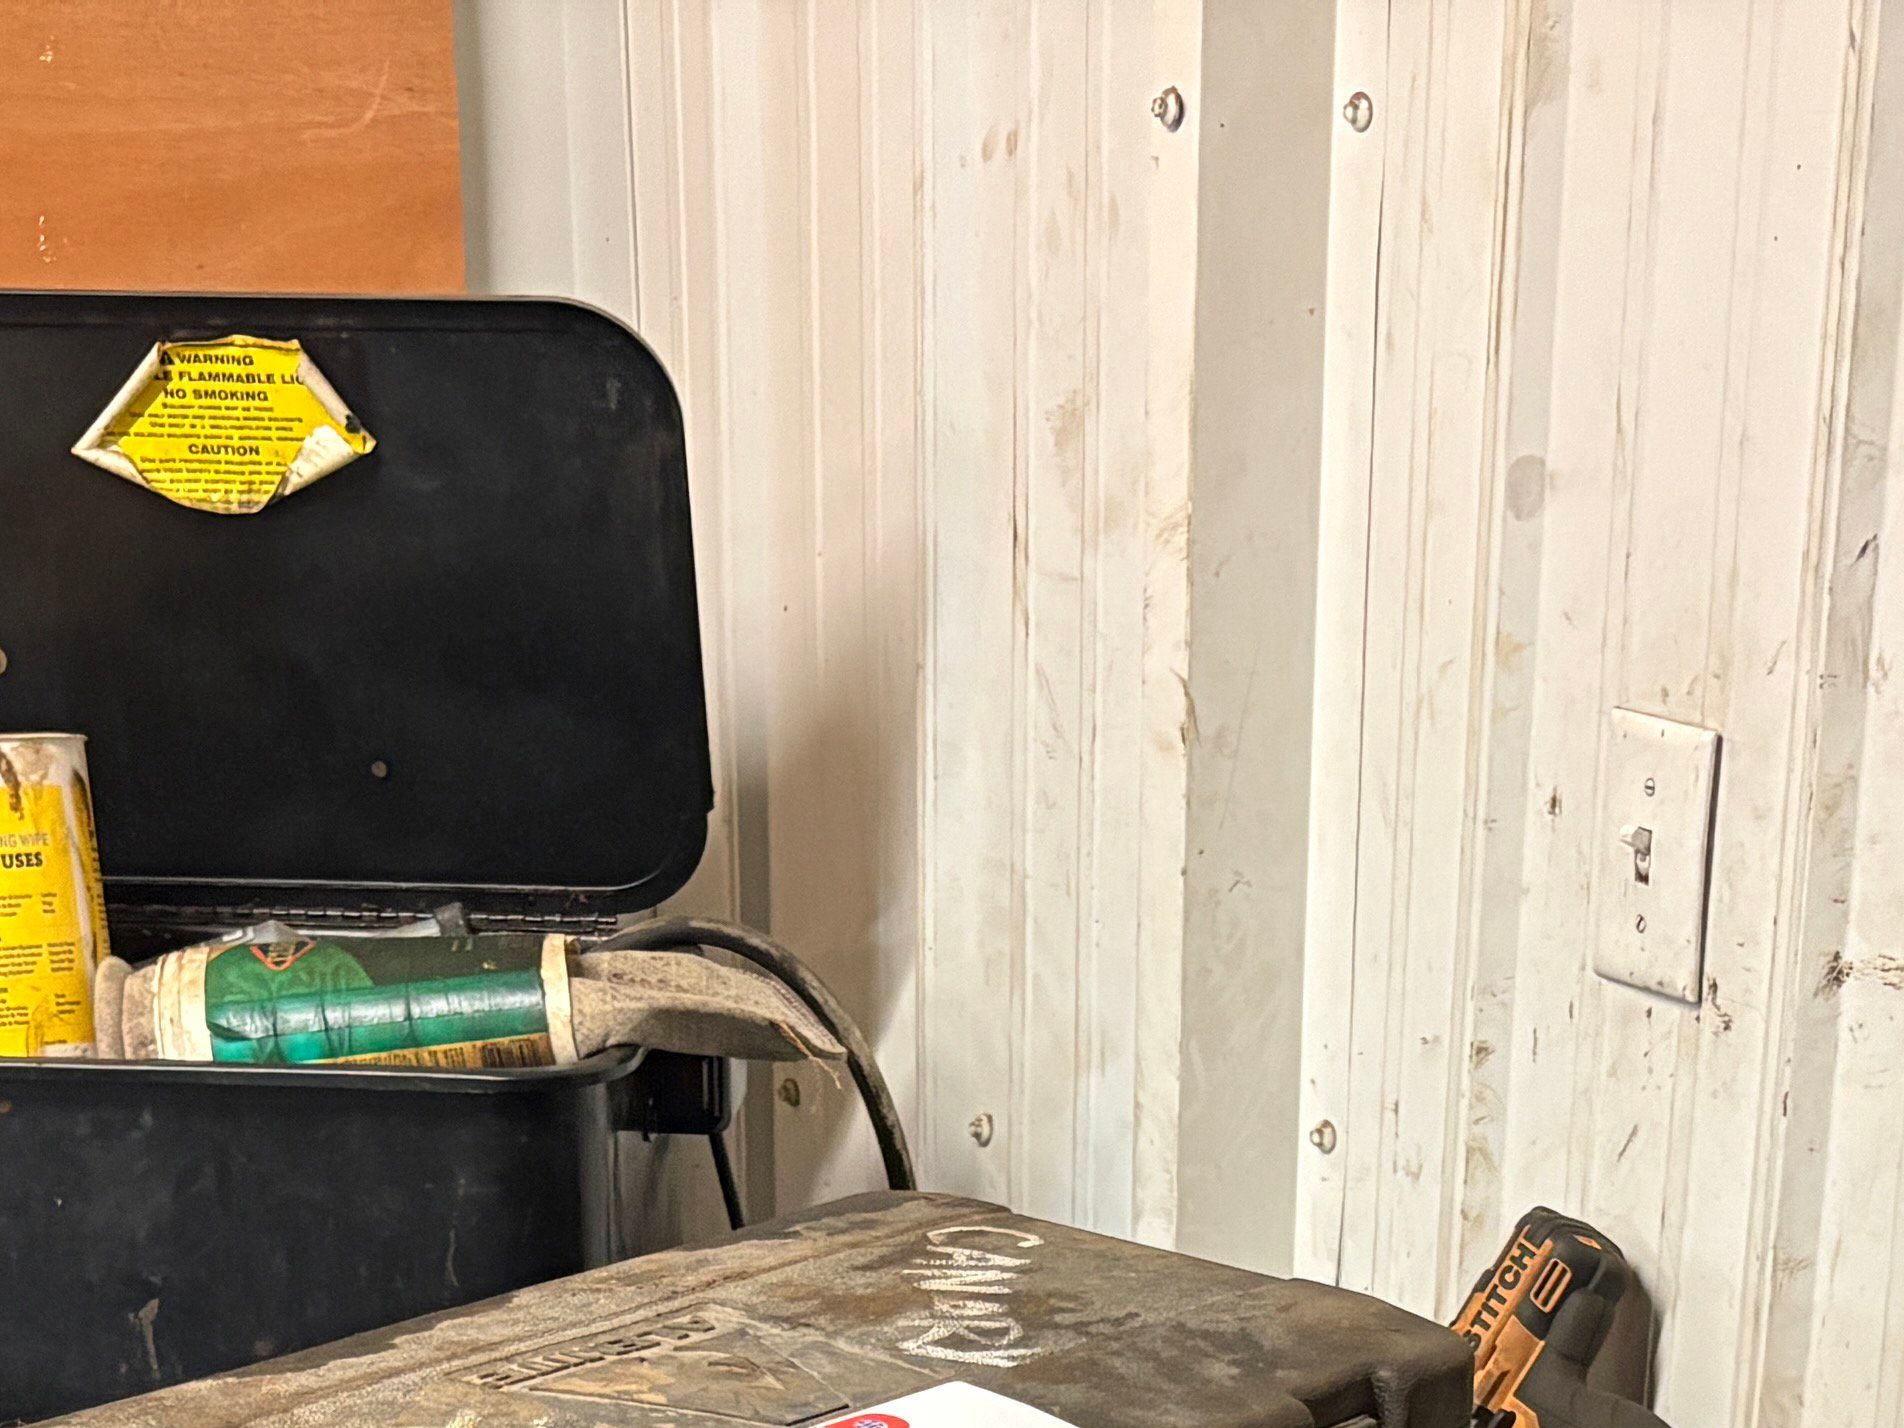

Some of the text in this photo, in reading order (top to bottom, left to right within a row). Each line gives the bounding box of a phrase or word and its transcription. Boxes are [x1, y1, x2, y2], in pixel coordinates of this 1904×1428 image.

[178, 354, 254, 366] WARNING
[179, 371, 275, 384] FLAMMABLE
[165, 388, 269, 402] NO SMOKING
[188, 444, 260, 456] CAUTION
[21, 832, 49, 847] WIPE
[2, 851, 44, 868] USES
